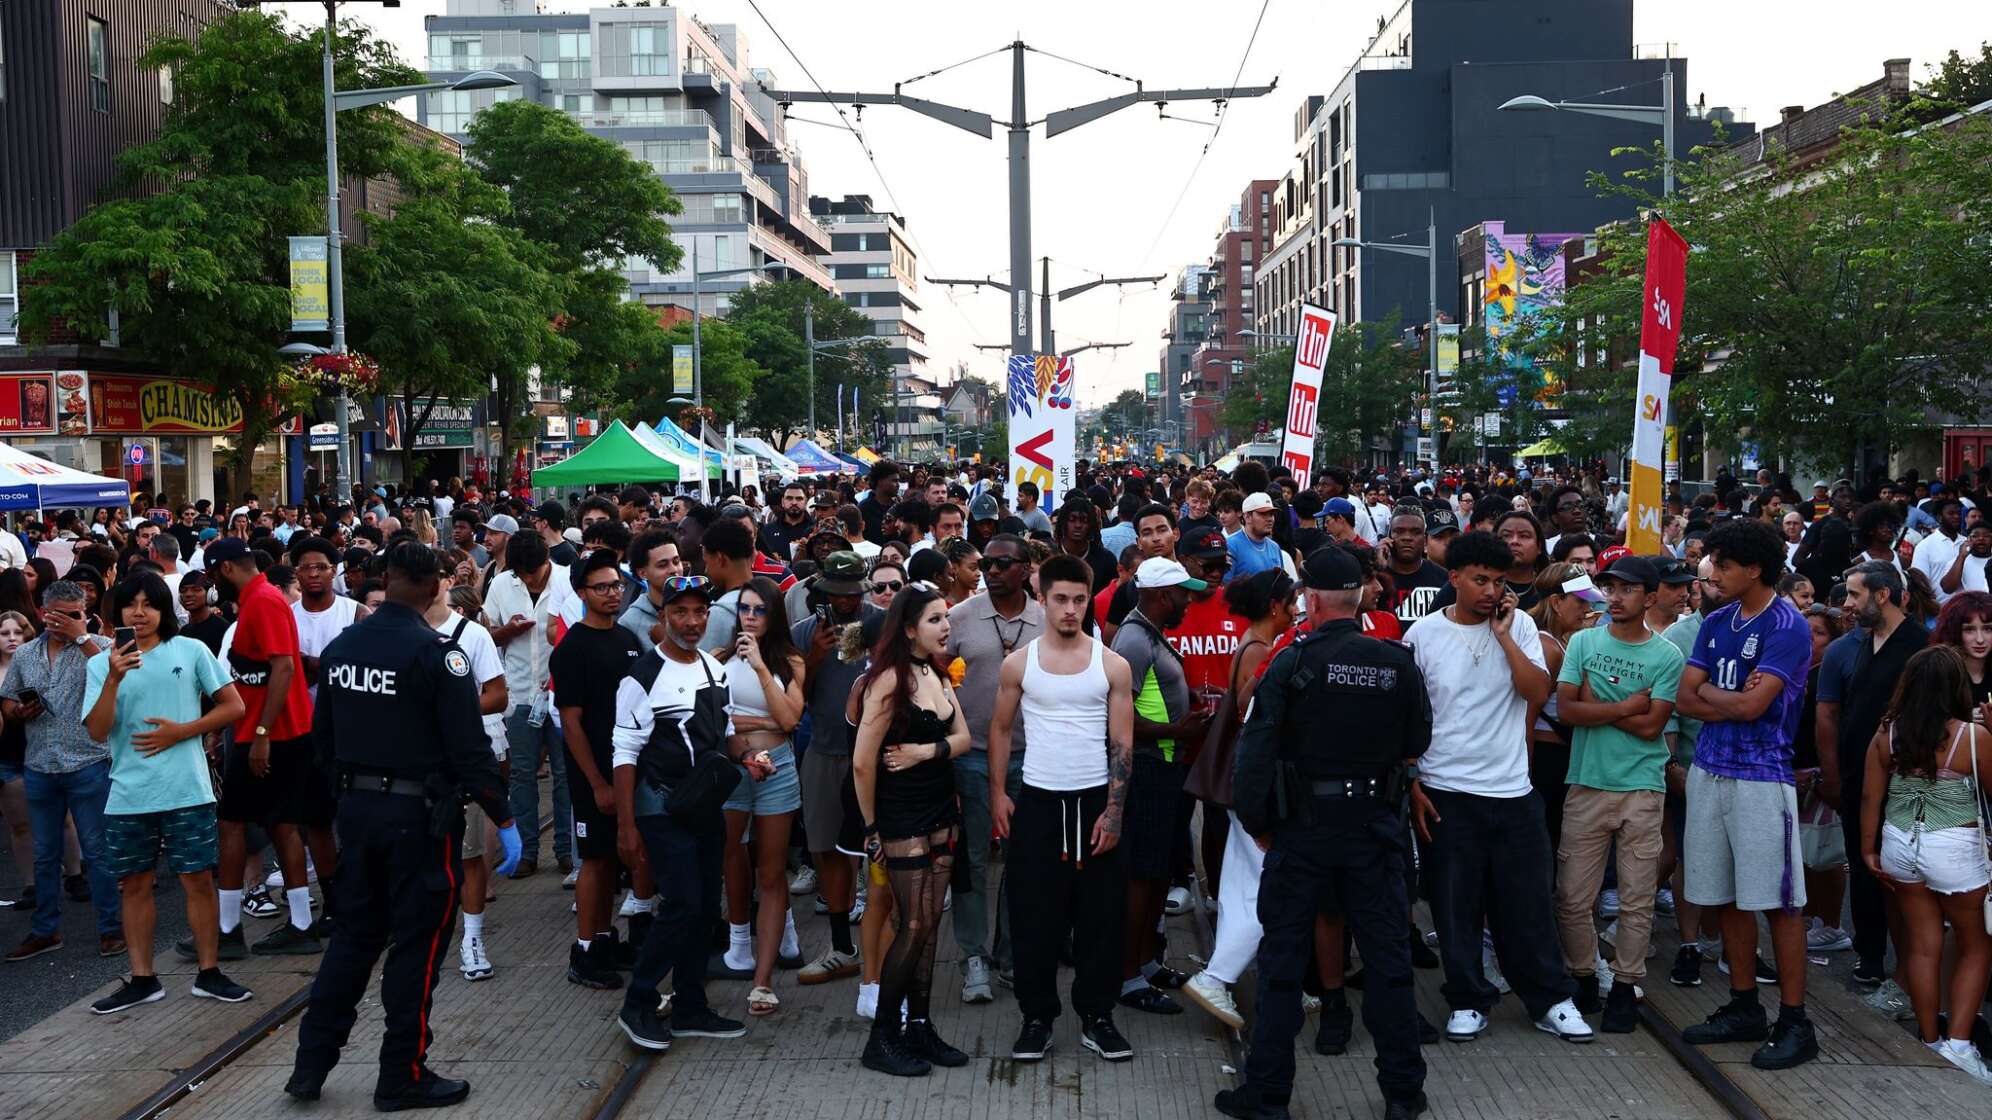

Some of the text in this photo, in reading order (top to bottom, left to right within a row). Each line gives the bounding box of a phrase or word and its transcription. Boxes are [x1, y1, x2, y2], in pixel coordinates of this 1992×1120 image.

[142, 384, 241, 427] CHAMSINE
[1166, 634, 1240, 656] CANADA
[1327, 663, 1378, 676] TORONTO
[1589, 660, 1645, 681] HILFIGER
[1596, 653, 1645, 672] TOMMY
[328, 663, 397, 695] POLICE
[1327, 672, 1377, 687] POLICE
[1716, 657, 1738, 690] 10
